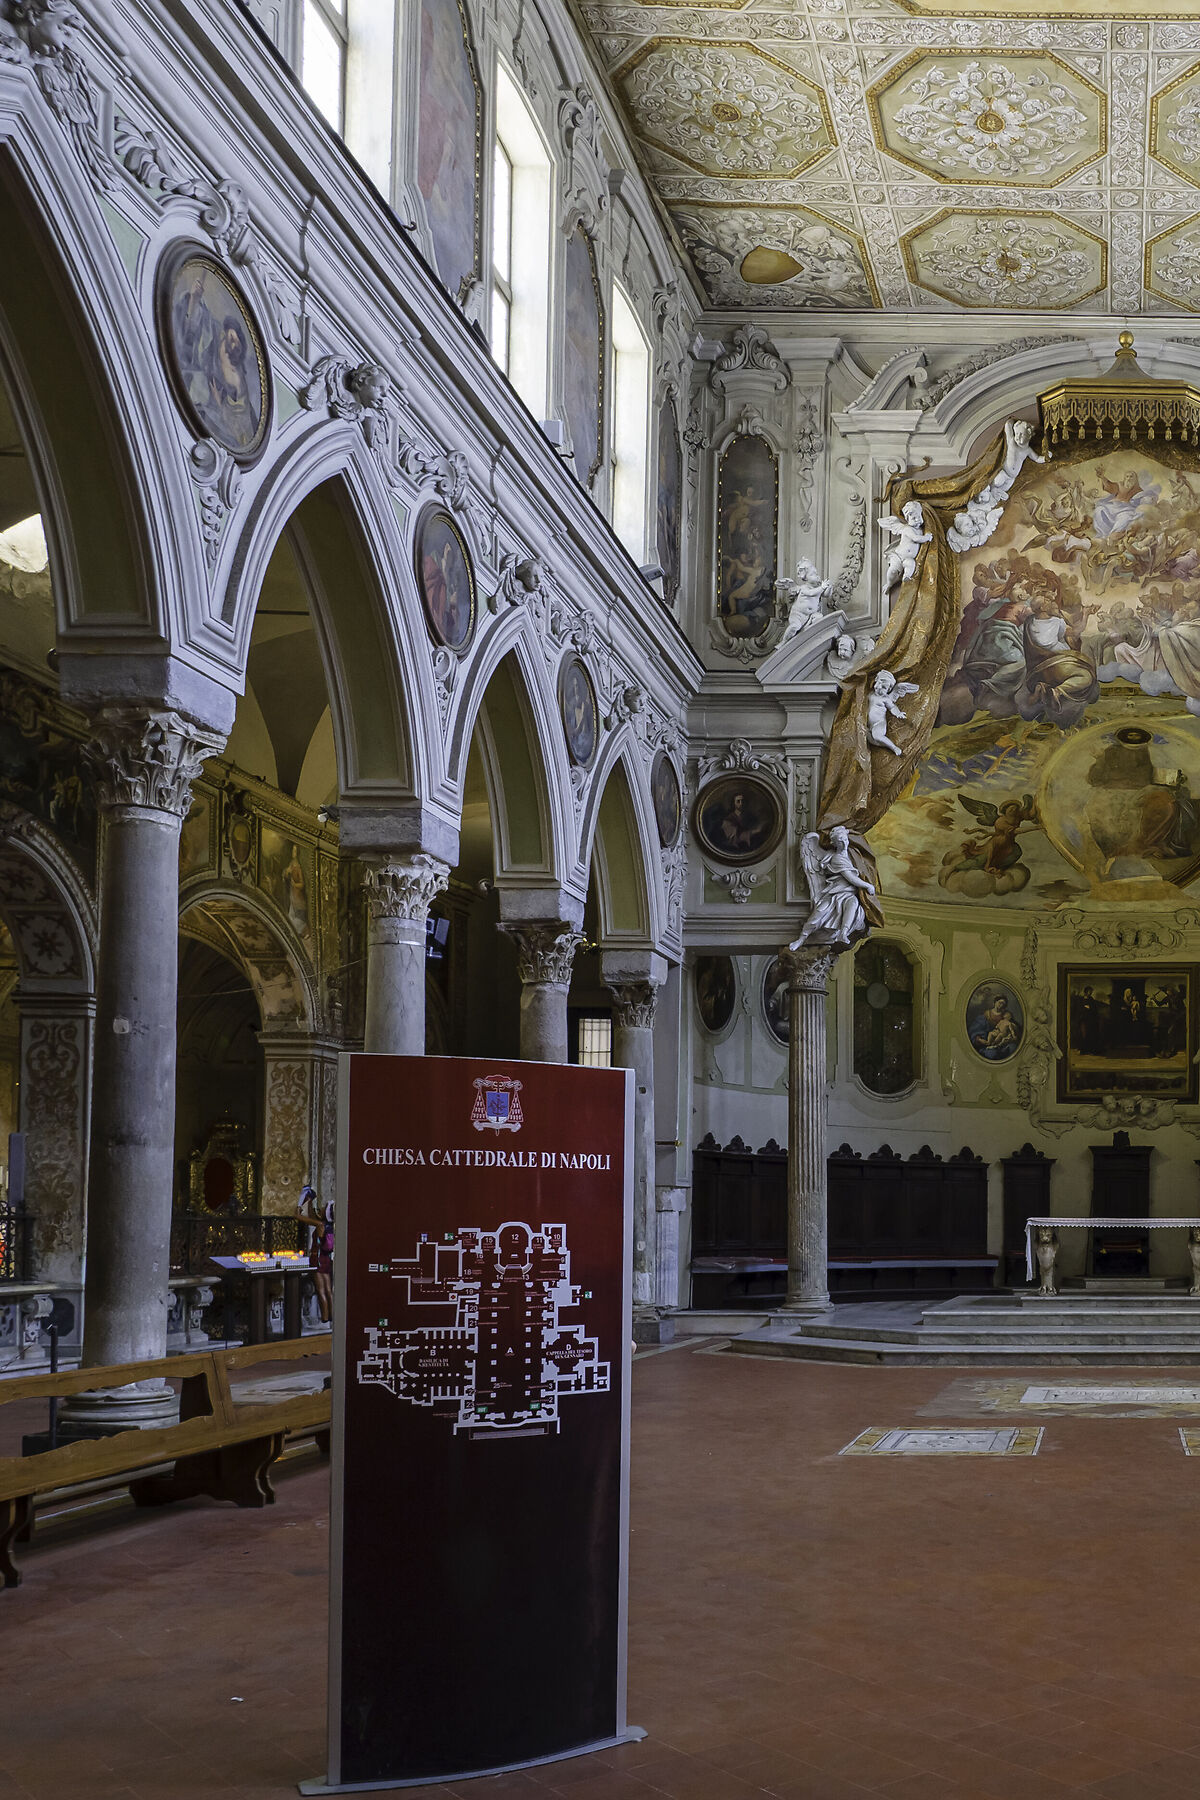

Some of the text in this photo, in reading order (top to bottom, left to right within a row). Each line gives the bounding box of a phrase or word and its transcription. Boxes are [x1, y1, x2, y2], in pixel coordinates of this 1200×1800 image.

[362, 1147, 611, 1170] CHIESA CATTEDRALE DI NAPOLI
